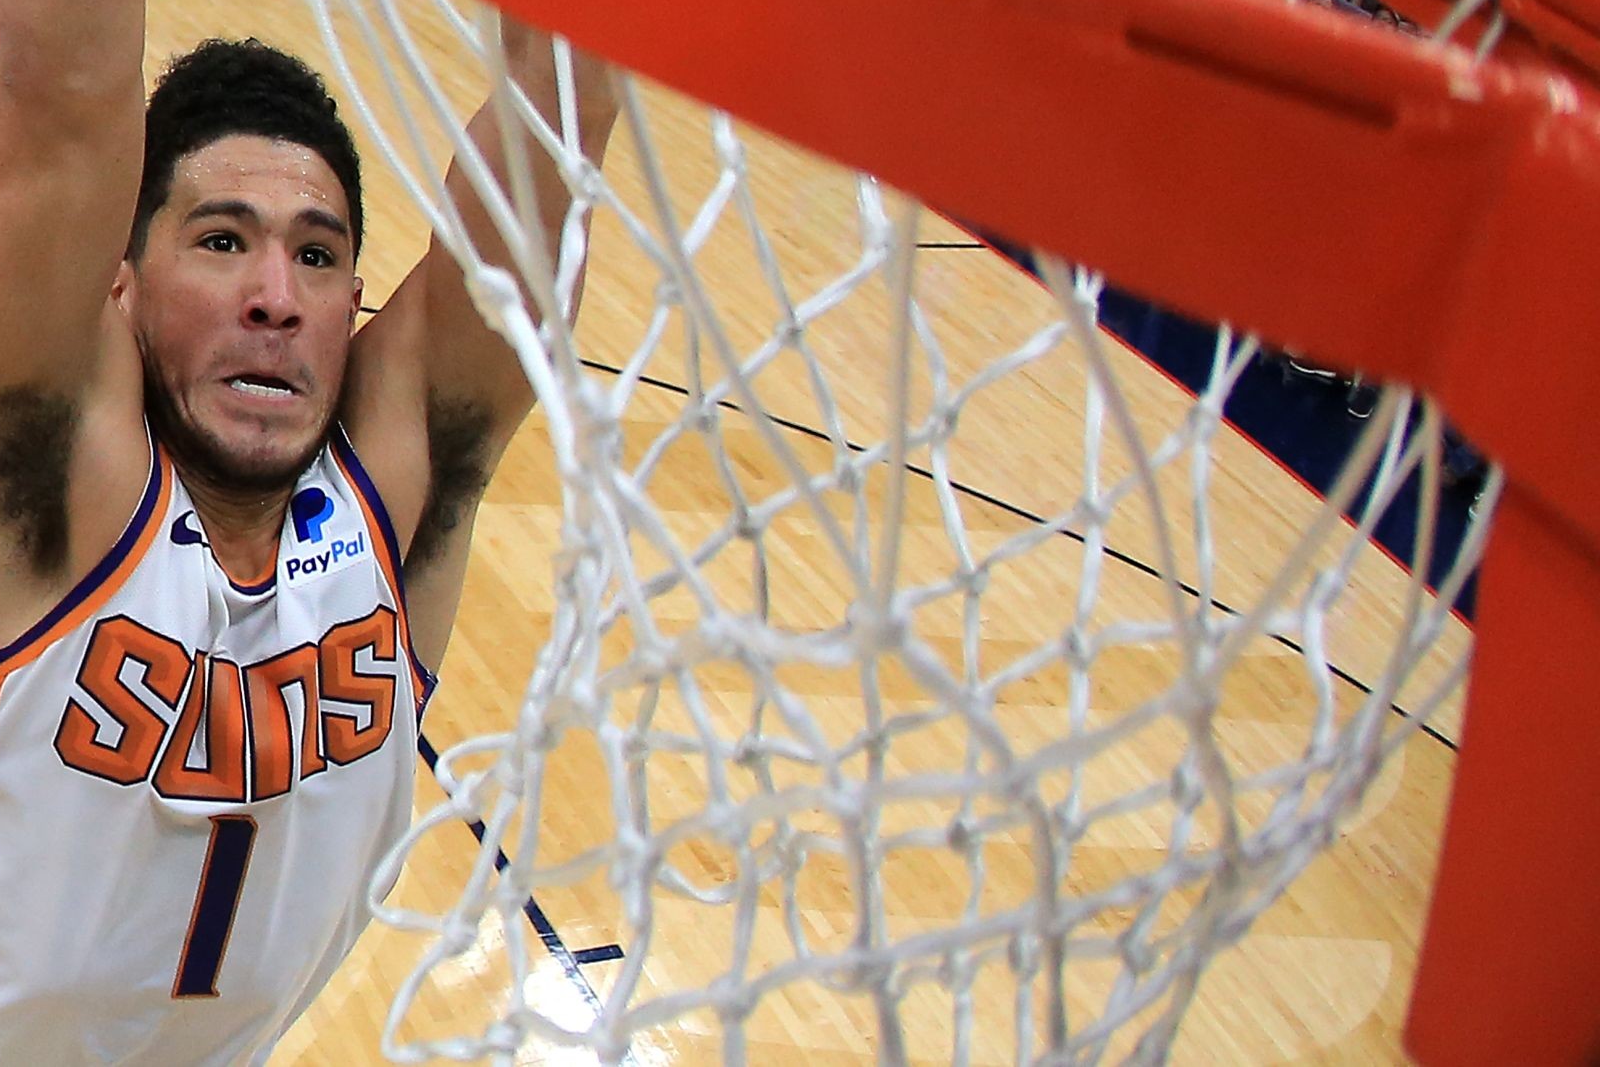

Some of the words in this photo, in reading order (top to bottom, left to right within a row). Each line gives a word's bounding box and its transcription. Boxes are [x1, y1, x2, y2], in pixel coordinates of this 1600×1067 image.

[286, 531, 364, 580] PayPal
[52, 603, 398, 804] SUNS
[171, 813, 259, 1000] 1
